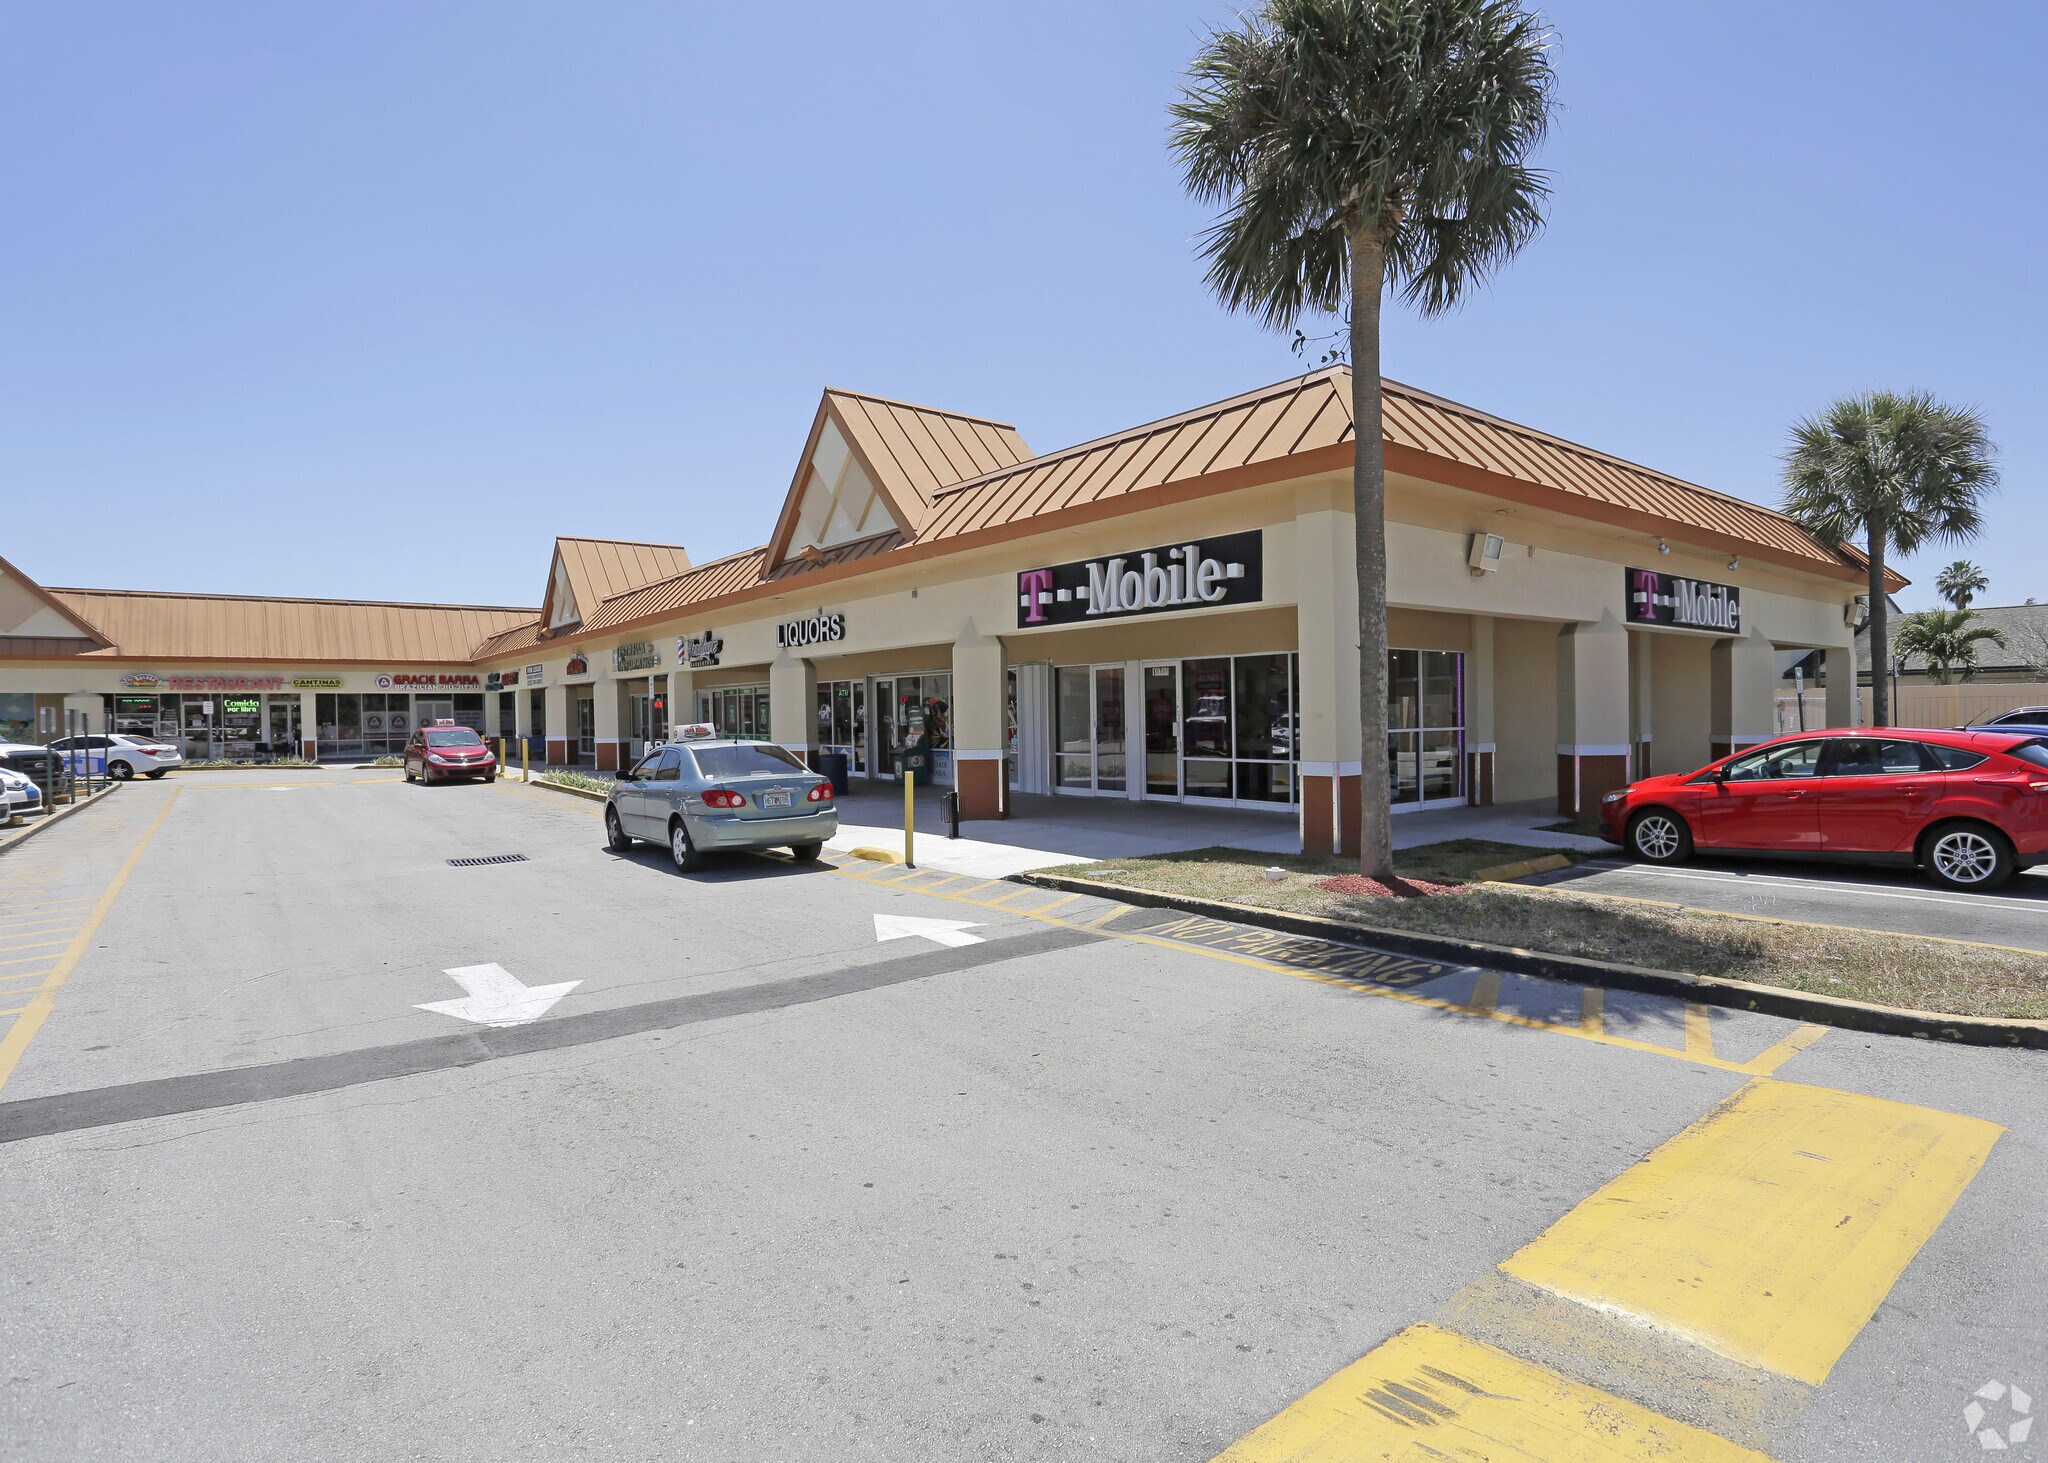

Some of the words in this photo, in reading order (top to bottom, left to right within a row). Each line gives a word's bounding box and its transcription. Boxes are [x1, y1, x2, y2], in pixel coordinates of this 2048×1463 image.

[777, 614, 845, 648] LIQUORS
[617, 642, 647, 658] ESTRELLA
[618, 656, 655, 671] INSURANCE
[169, 677, 284, 690] RESTAURANT
[394, 674, 435, 684] GRACIE
[439, 674, 479, 684] BARRA
[1136, 915, 1233, 938] NO
[1206, 930, 1443, 985] PARKING
